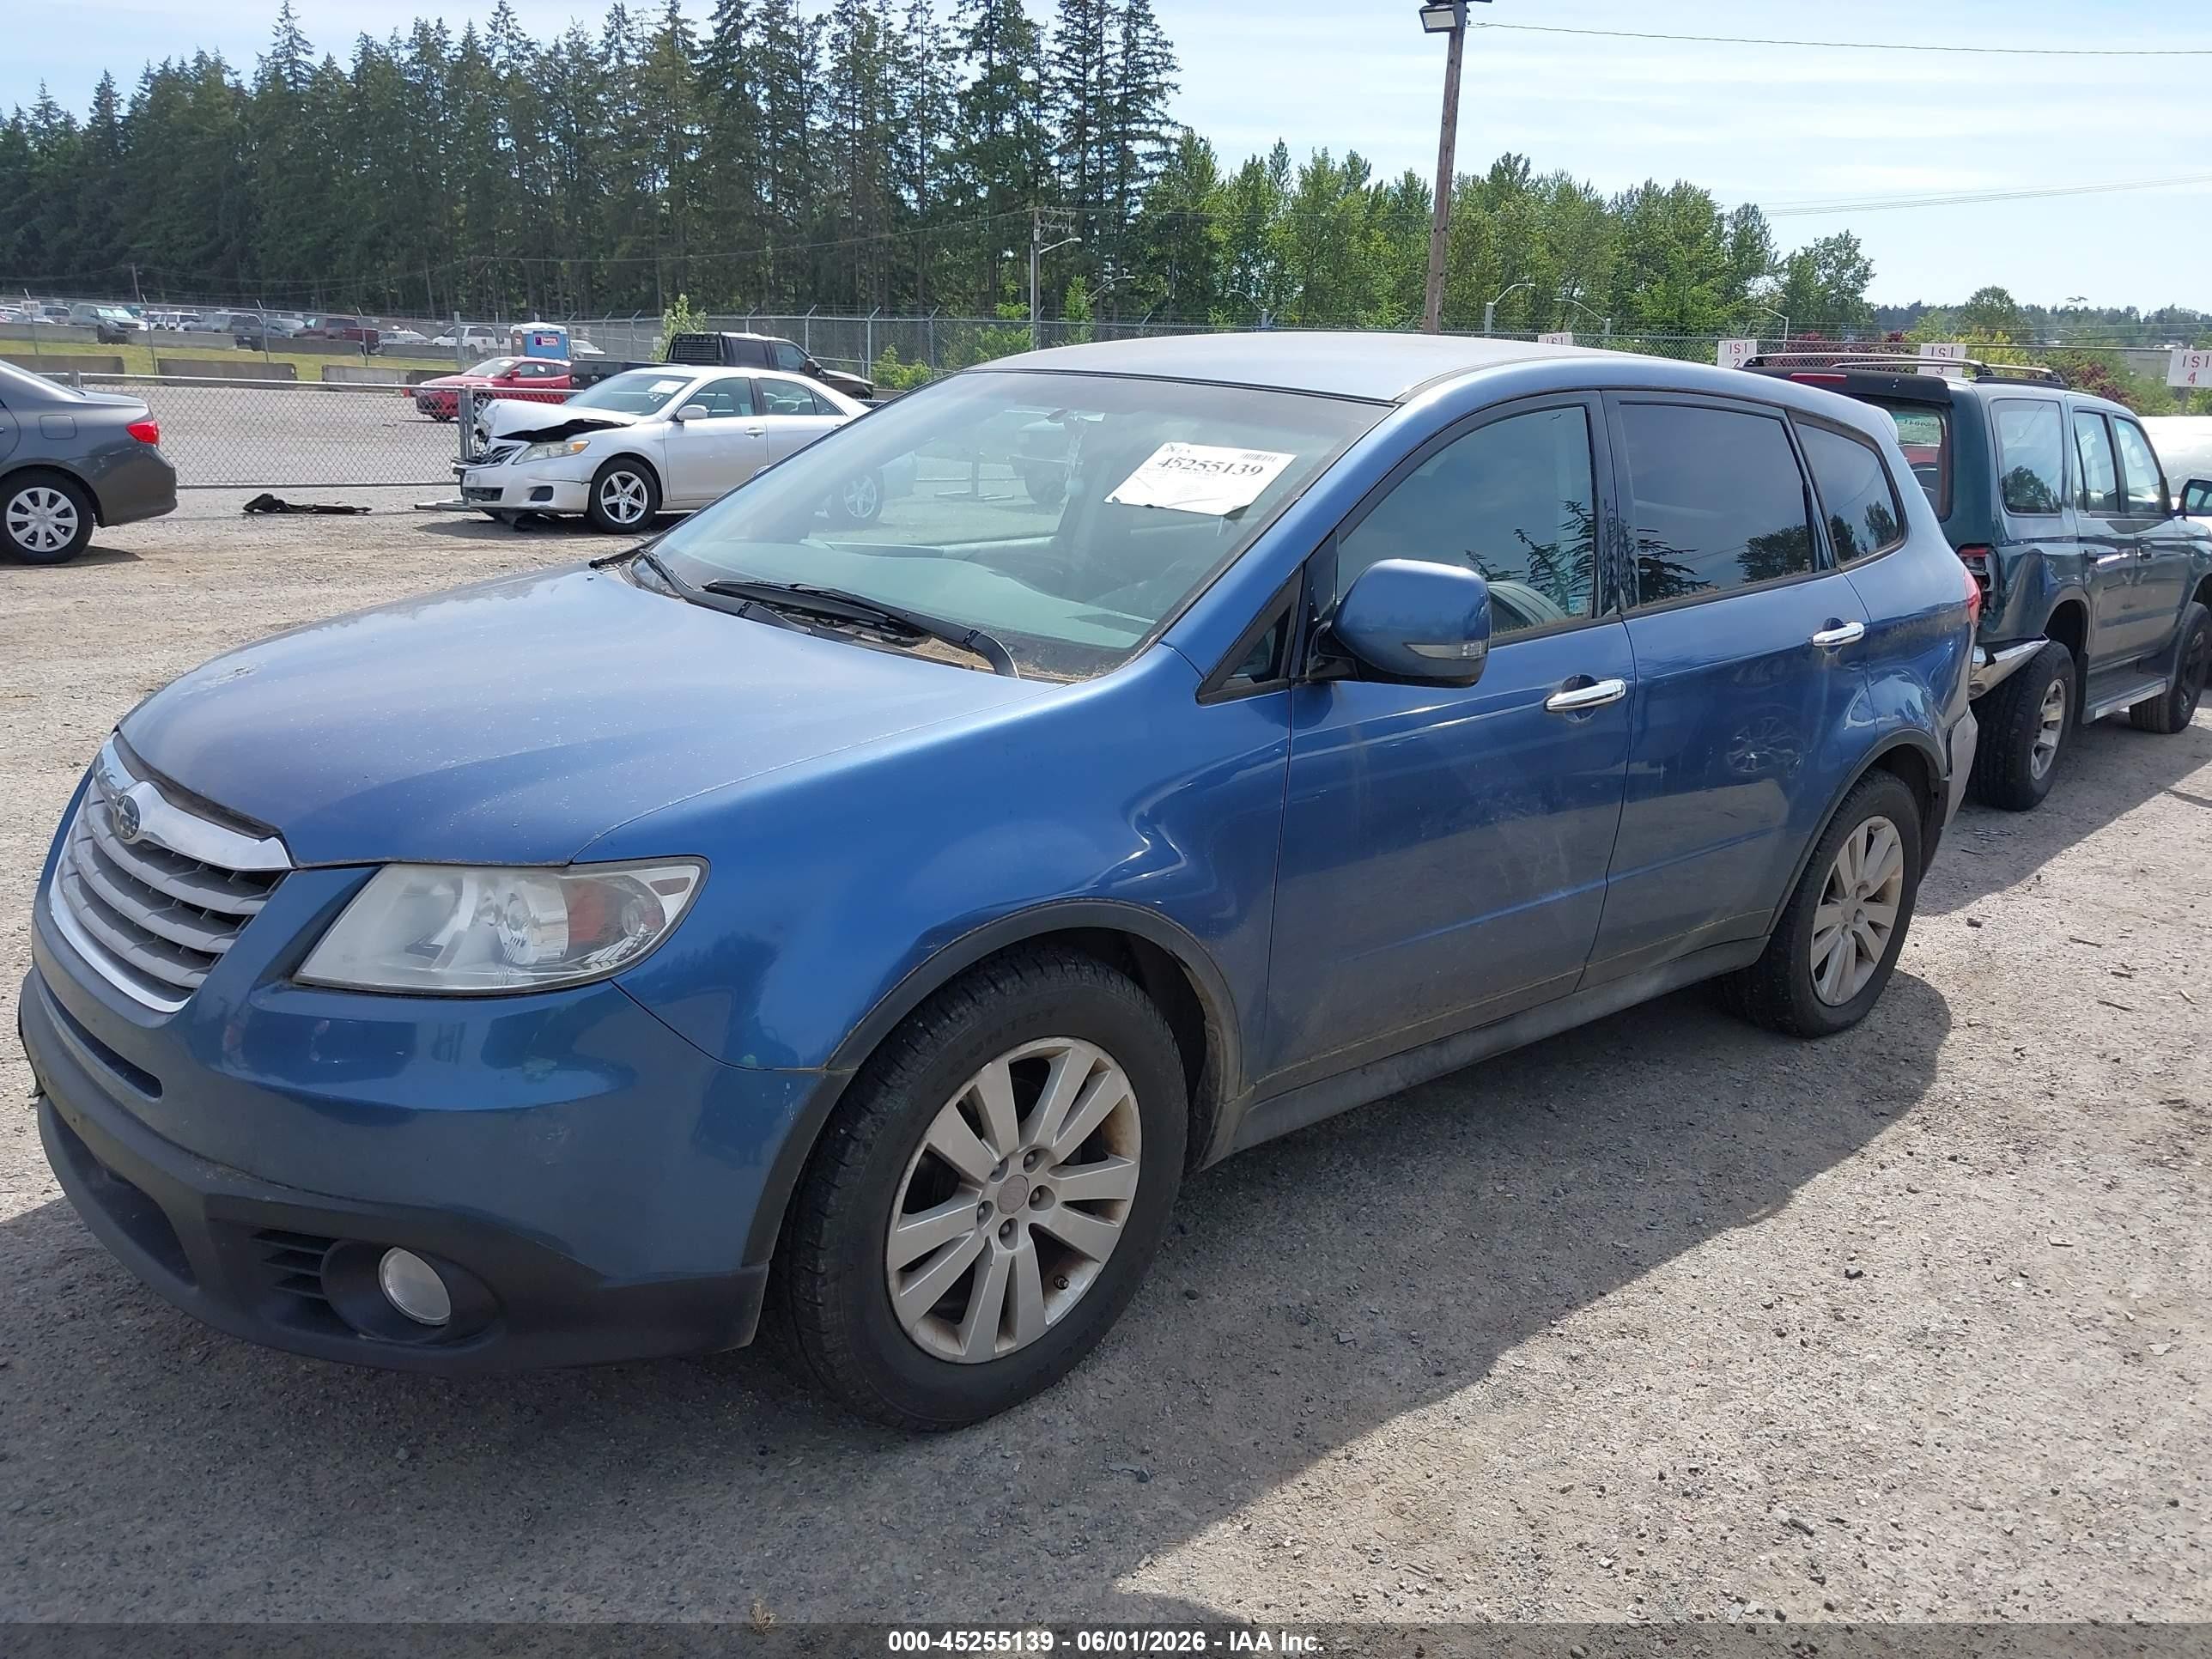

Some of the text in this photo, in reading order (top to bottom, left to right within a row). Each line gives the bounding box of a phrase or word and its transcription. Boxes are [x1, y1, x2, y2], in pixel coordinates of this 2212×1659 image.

[1733, 357, 1741, 368] 2
[1936, 365, 1944, 375] 3
[2187, 371, 2197, 385] 4
[1157, 456, 1264, 477] 45255139
